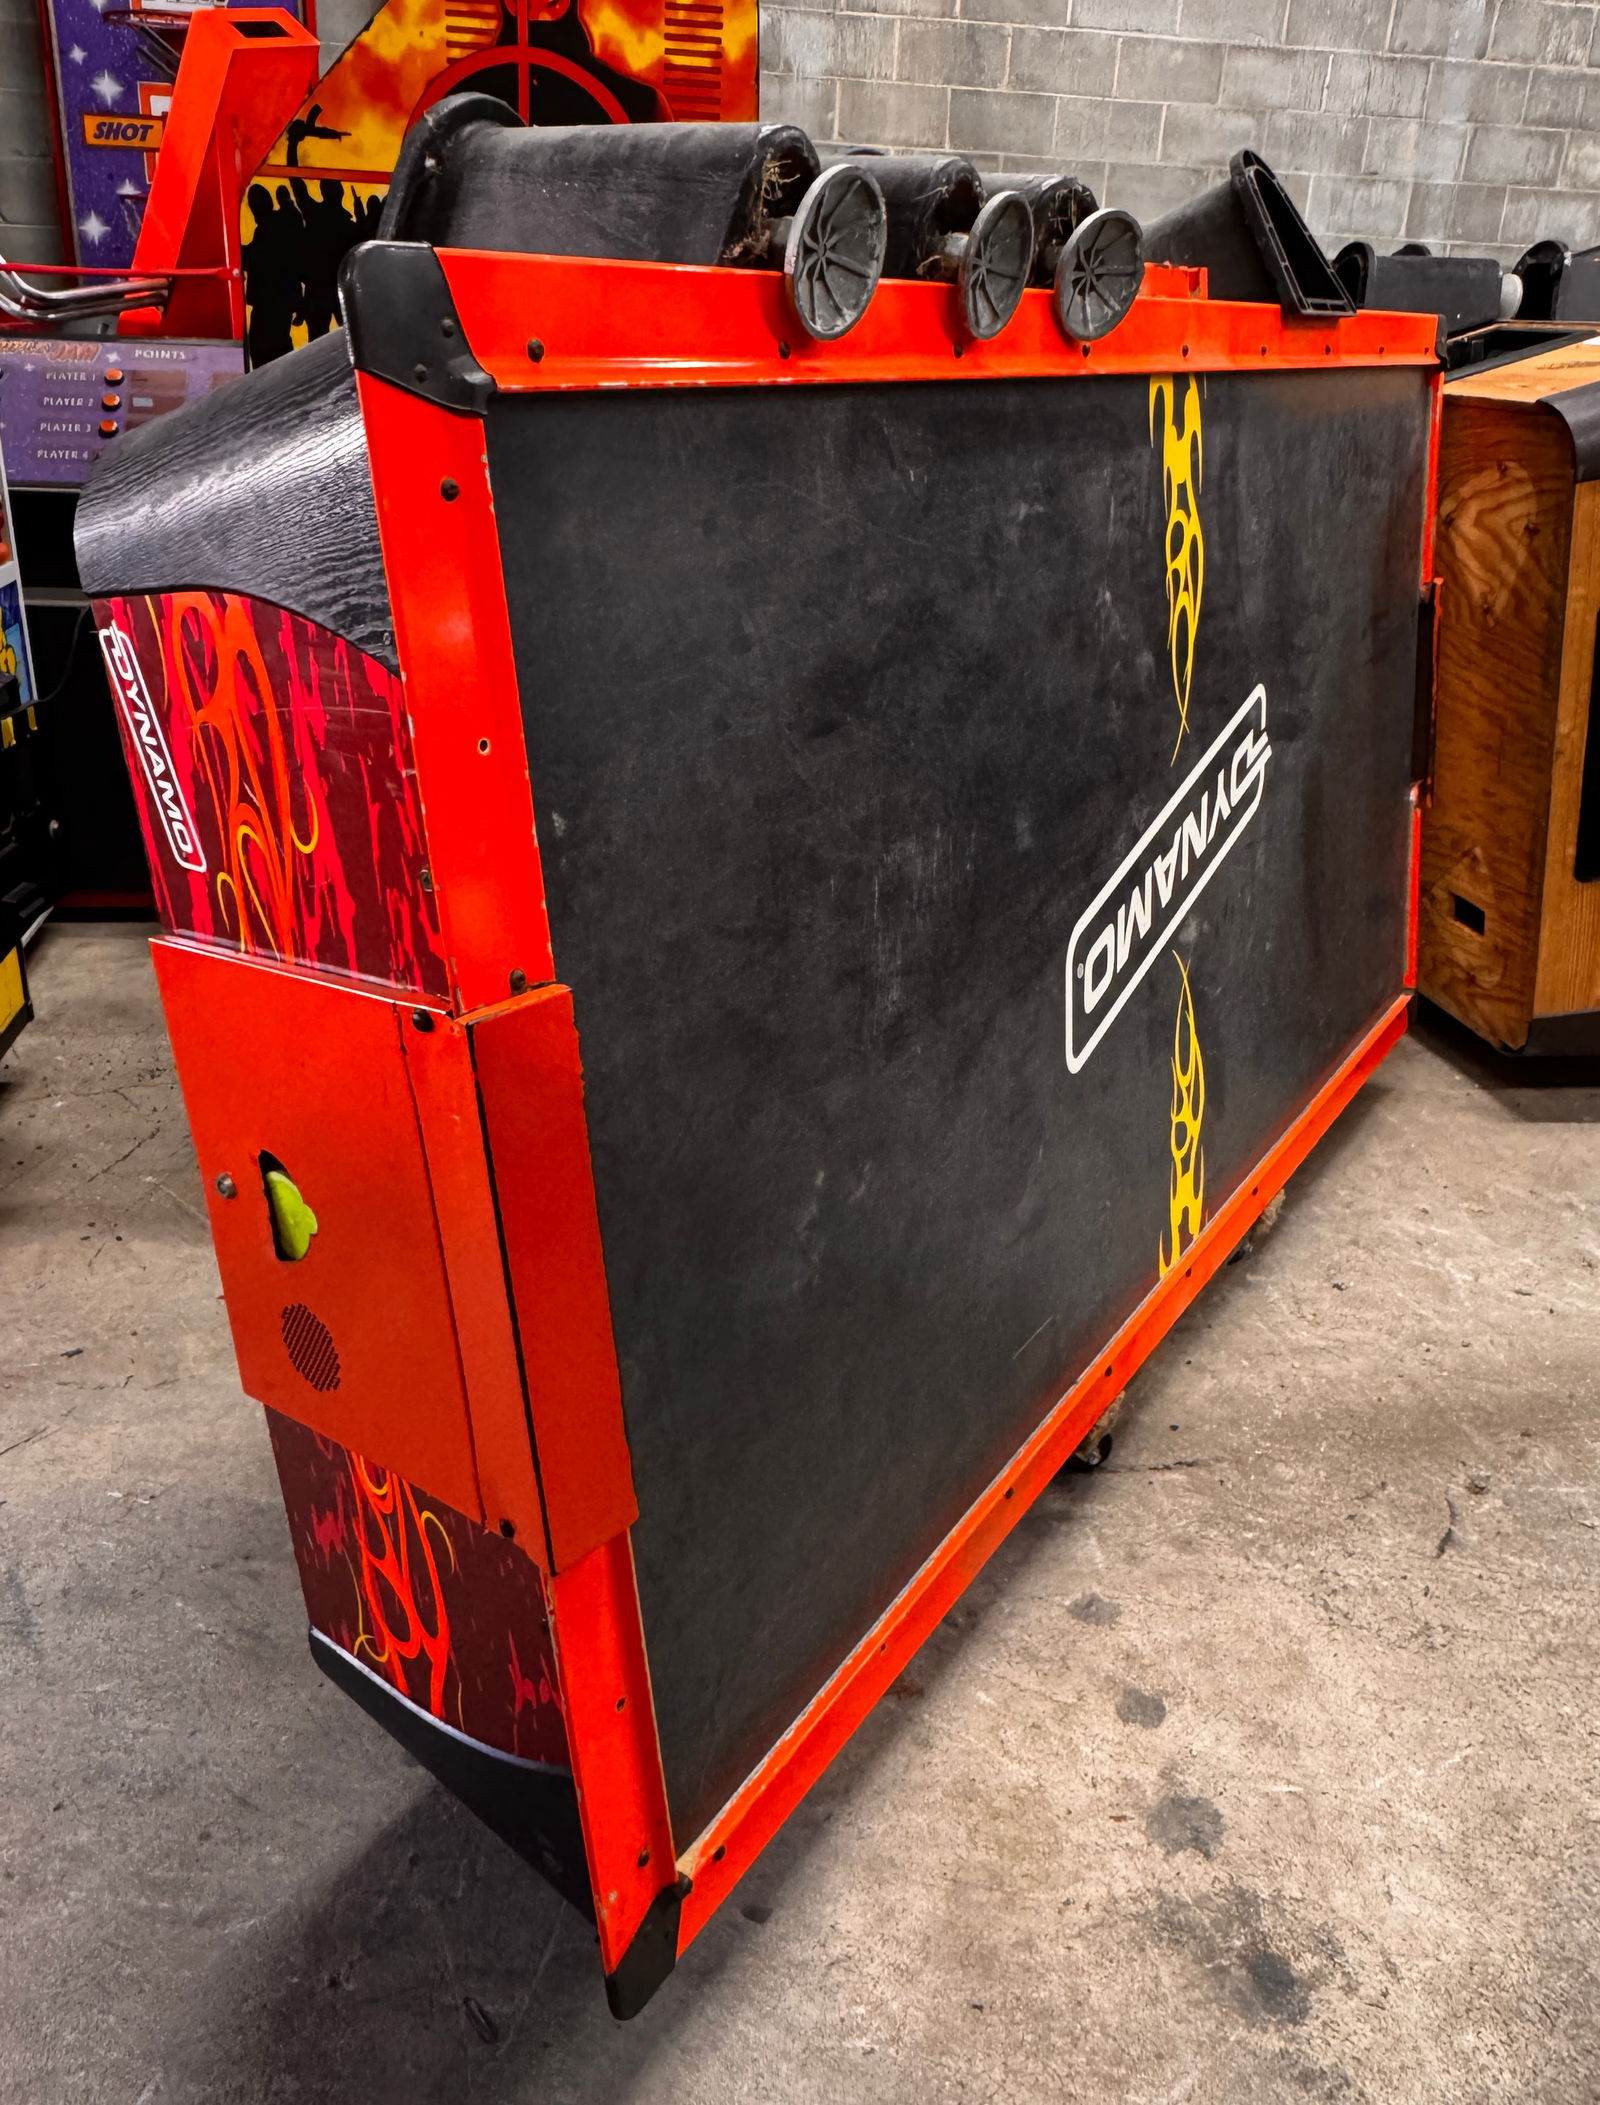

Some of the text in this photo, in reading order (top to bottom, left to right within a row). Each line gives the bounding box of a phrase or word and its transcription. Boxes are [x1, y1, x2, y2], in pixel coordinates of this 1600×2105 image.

[93, 121, 154, 142] SHOT
[135, 349, 186, 360] POINTS
[46, 371, 87, 381] PLAYER
[43, 396, 94, 407] PLAYER 2
[40, 422, 92, 433] PLAYER 3
[37, 449, 78, 460] PLAYER
[110, 620, 194, 854] DYNAMO
[1084, 729, 1273, 1014] DYNAMO
